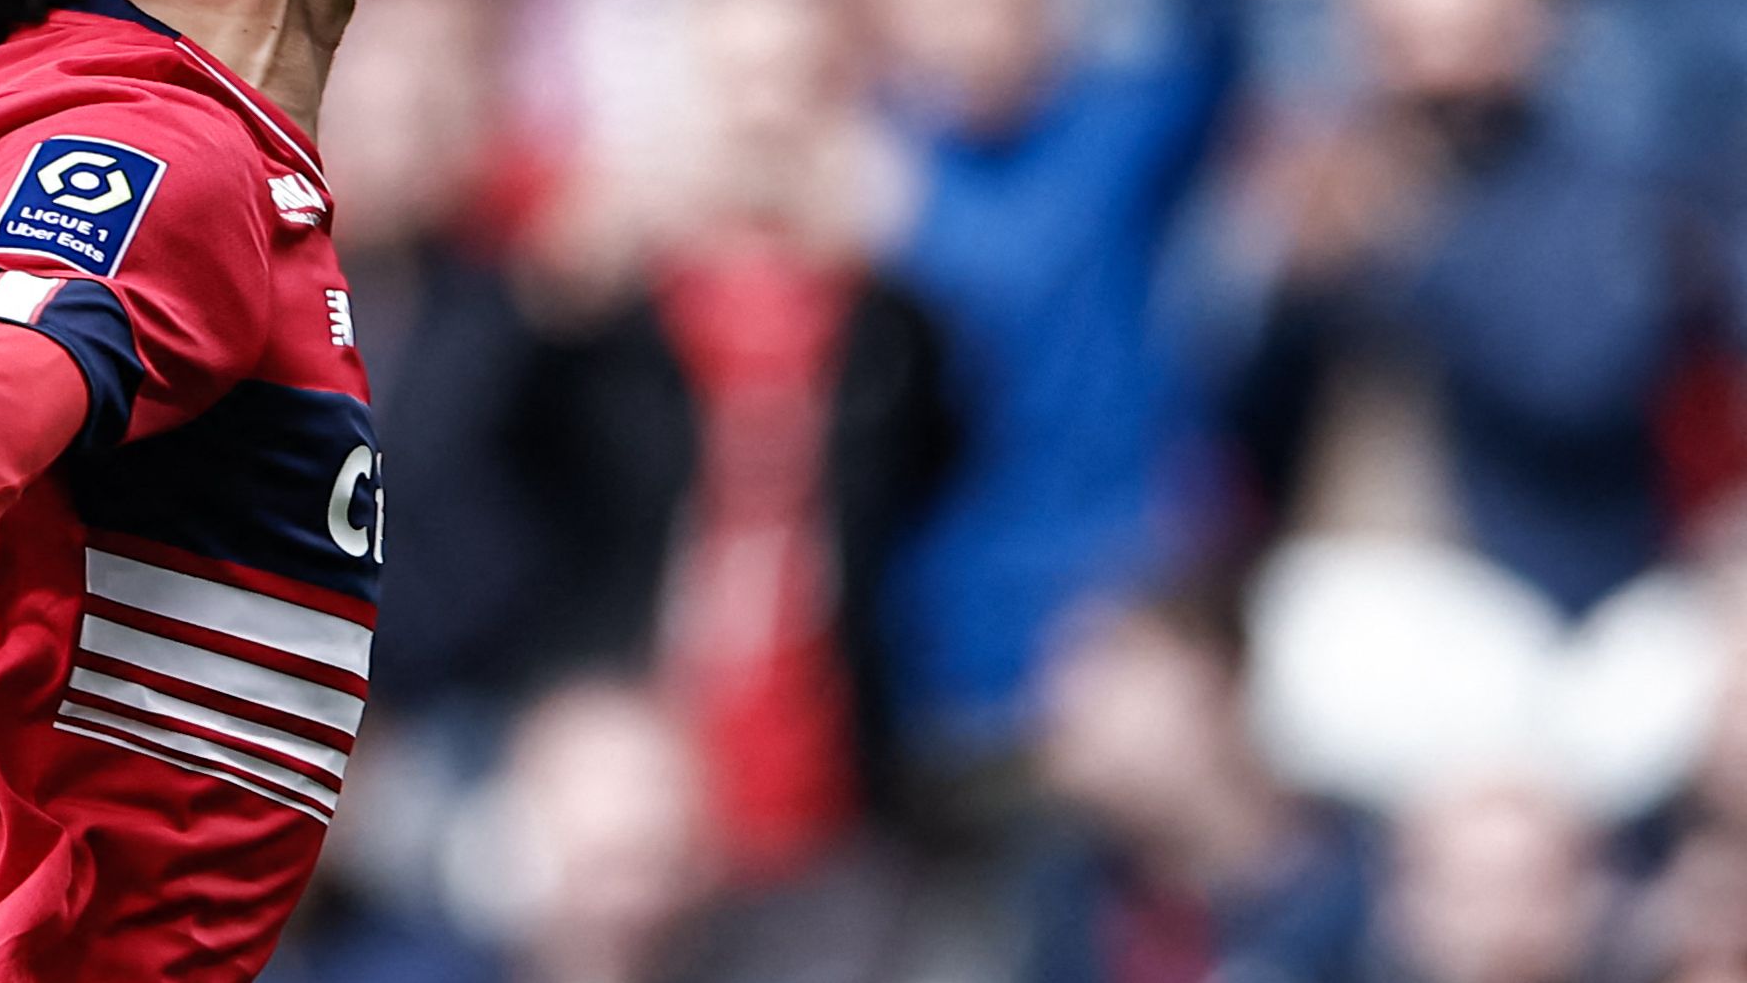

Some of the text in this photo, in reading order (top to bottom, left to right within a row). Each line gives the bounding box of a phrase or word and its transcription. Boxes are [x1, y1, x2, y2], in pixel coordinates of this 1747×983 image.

[6, 220, 106, 263] Uber Eats
[20, 206, 109, 243] LIGUE 1
